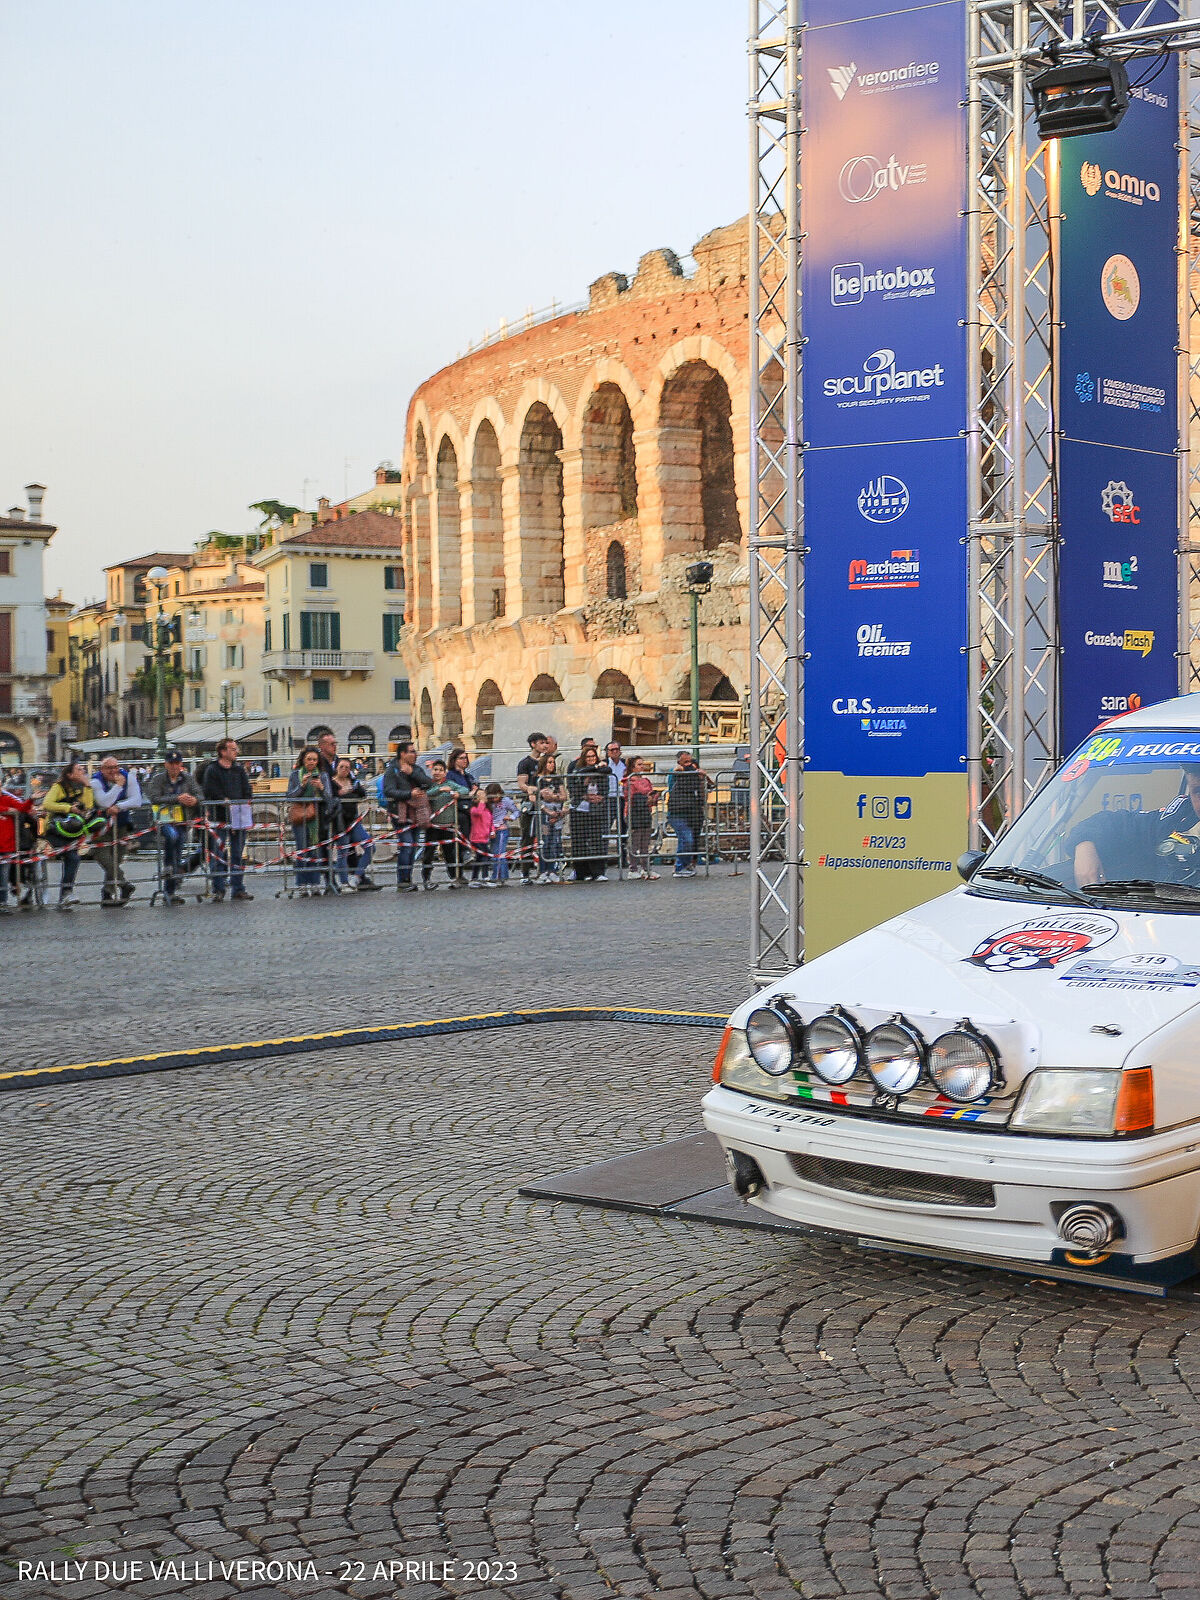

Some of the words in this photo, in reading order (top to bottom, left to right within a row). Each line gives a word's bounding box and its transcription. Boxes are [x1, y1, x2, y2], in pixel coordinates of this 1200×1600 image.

[856, 61, 940, 87] veronafiere
[875, 153, 909, 190] atv
[1104, 169, 1161, 202] amia
[834, 266, 936, 296] bentobox
[1112, 503, 1140, 524] SEC
[849, 559, 919, 583] Marchesini
[857, 643, 911, 656] Tecnica
[832, 698, 876, 715] C.R.S.
[1100, 694, 1128, 711] sara
[872, 719, 907, 730] VARTA
[861, 836, 906, 849] #R2V23
[818, 854, 952, 872] #lapassionenonsiferma
[1022, 920, 1112, 935] PALLADIO
[1011, 935, 1079, 946] HISTORIC
[1131, 956, 1168, 965] 319
[1066, 981, 1178, 992] CONCORRENTE
